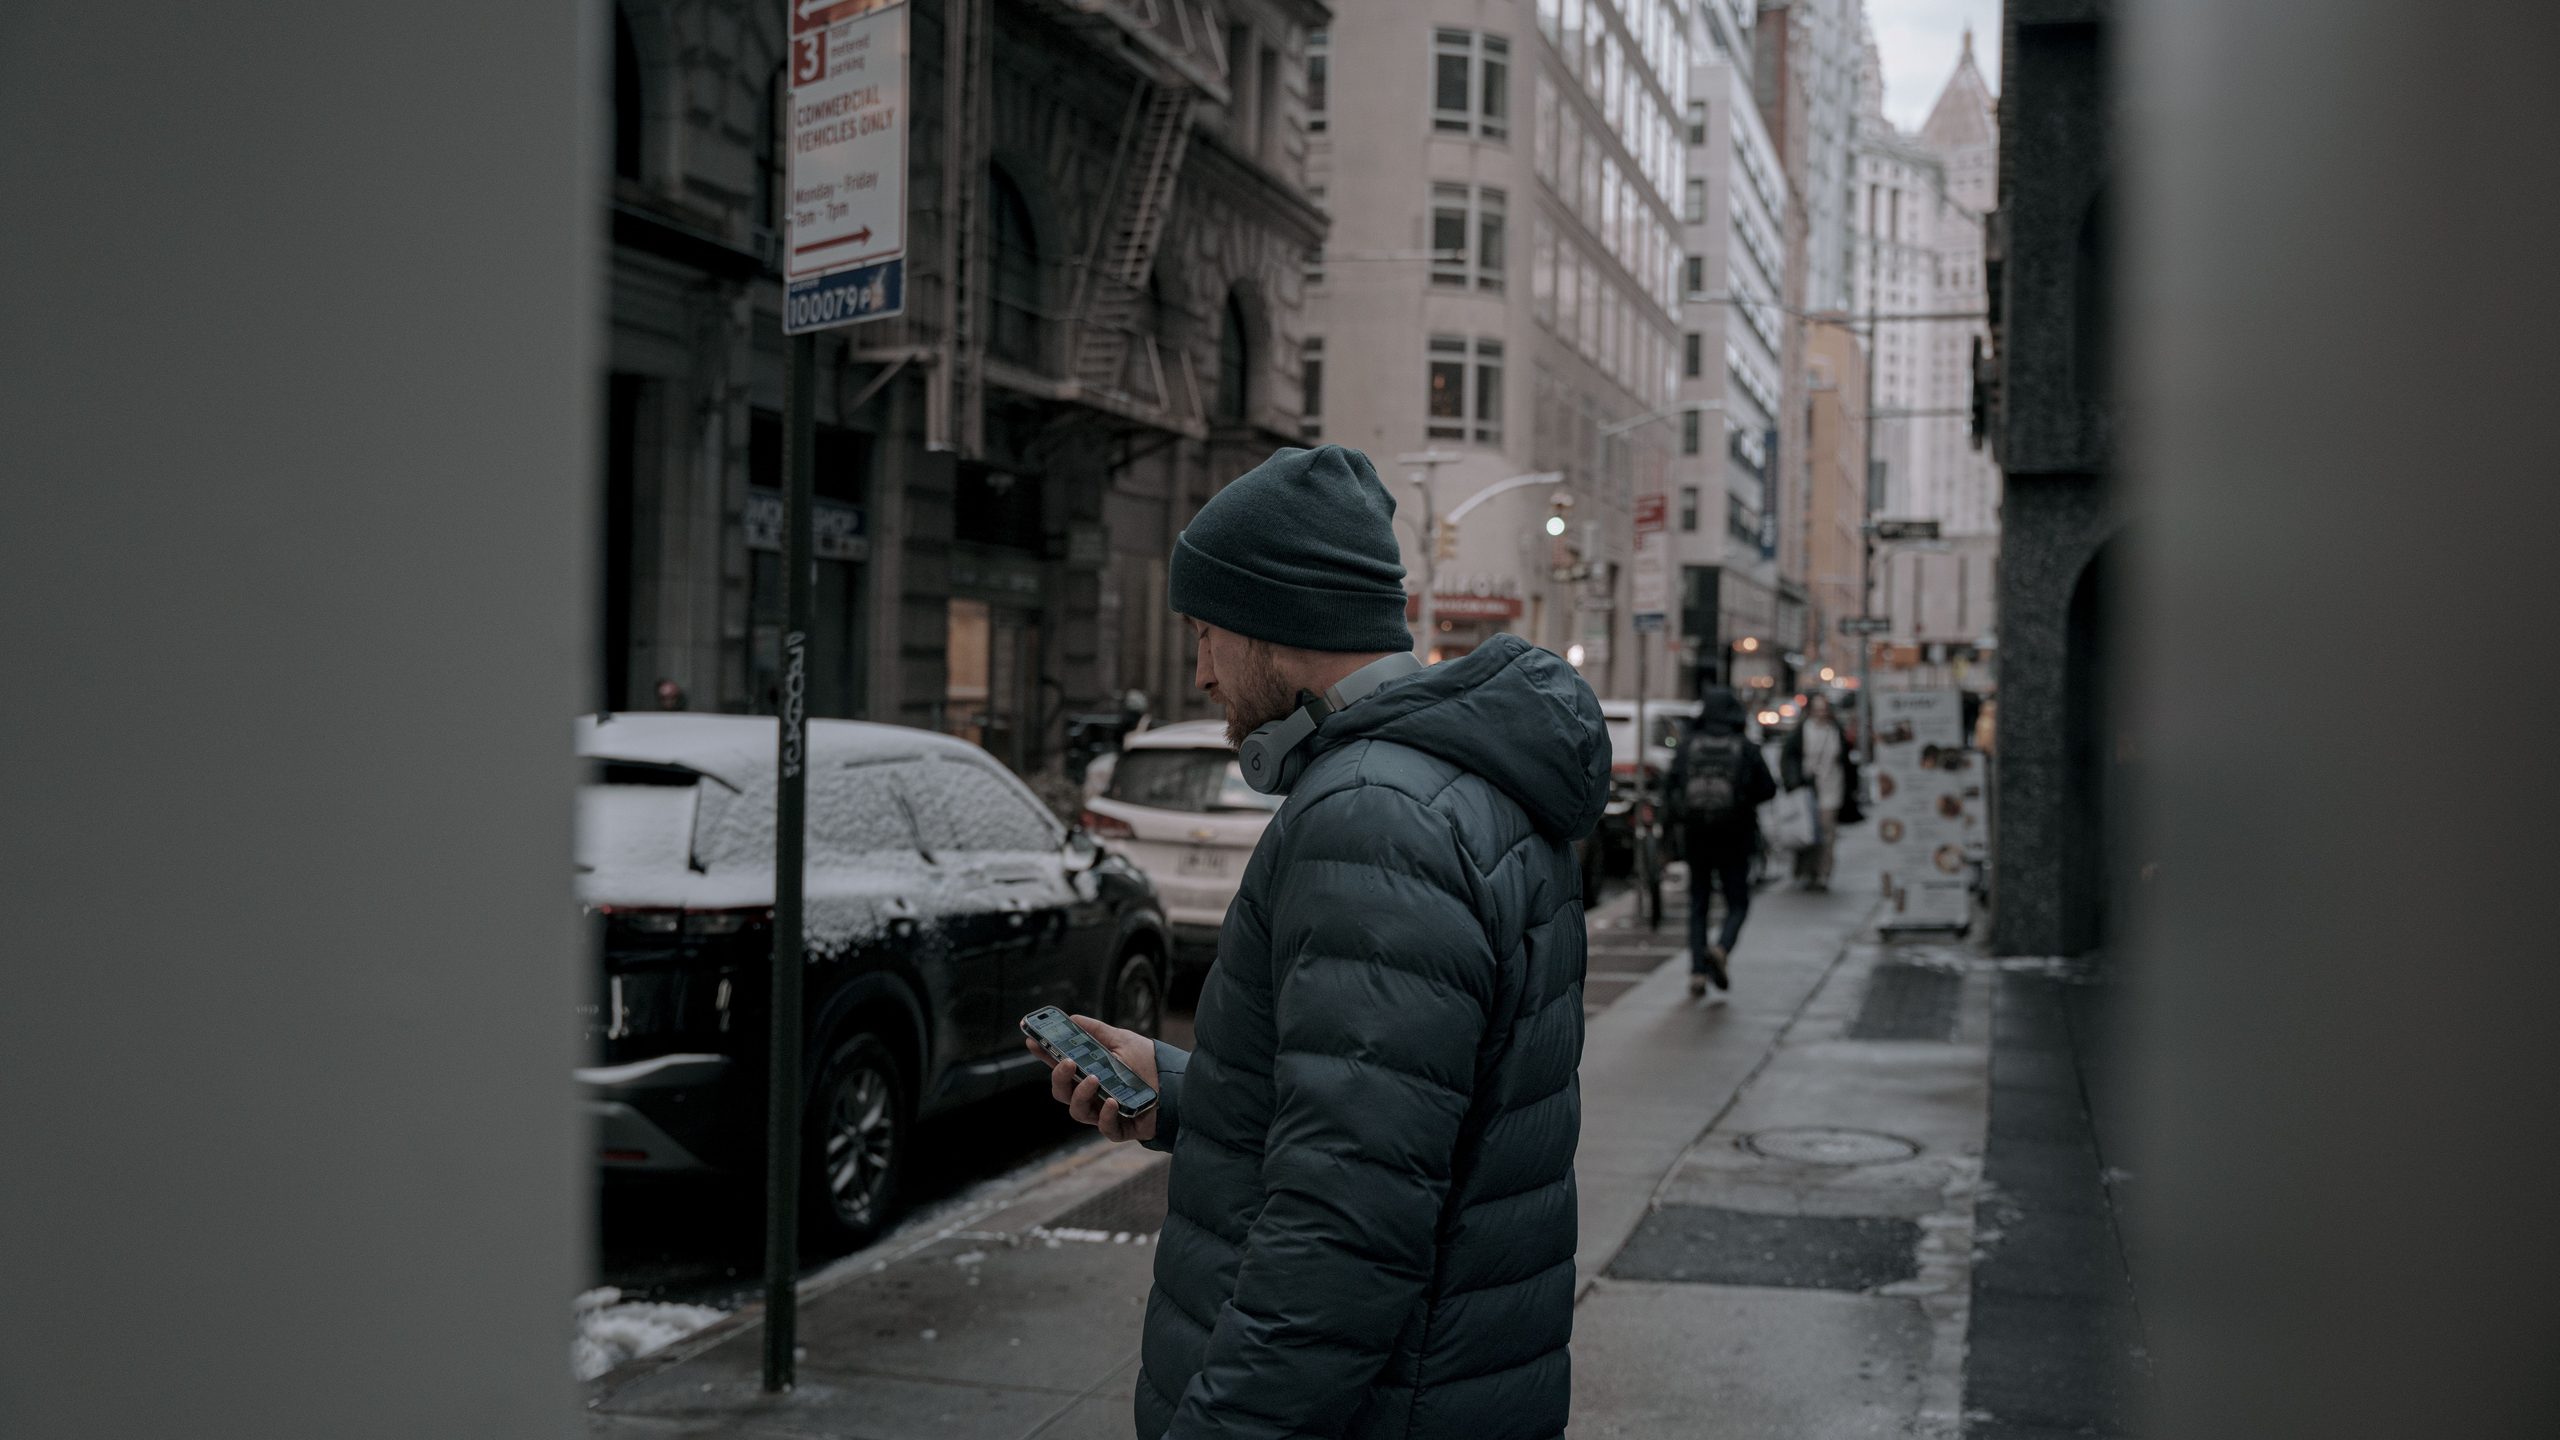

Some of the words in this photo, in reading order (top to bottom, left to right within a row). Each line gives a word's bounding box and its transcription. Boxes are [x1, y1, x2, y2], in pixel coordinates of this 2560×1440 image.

[799, 36, 819, 80] 3
[797, 84, 880, 127] COMMERCIAL
[797, 117, 857, 153] VEHICLES
[860, 106, 895, 137] ONLY
[796, 184, 834, 203] Monday
[845, 172, 878, 193] Friday
[796, 211, 816, 227] 7am
[827, 202, 848, 223] 7pm
